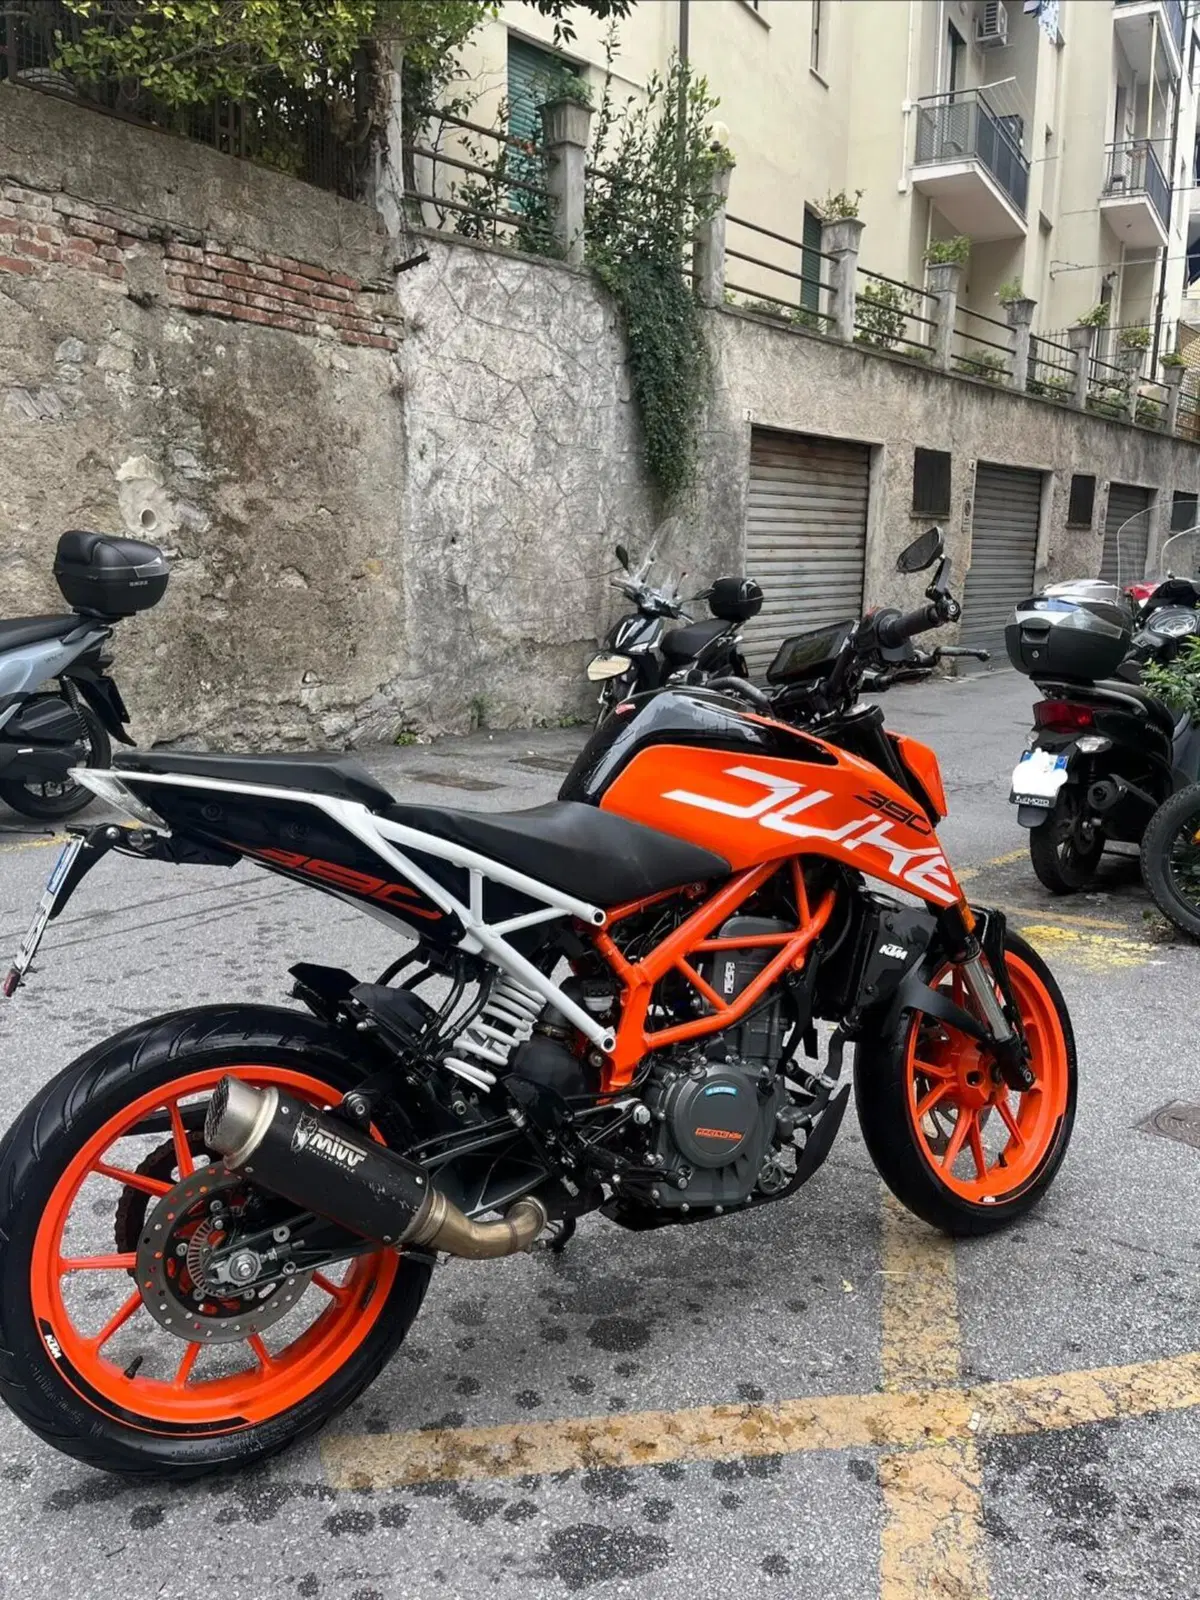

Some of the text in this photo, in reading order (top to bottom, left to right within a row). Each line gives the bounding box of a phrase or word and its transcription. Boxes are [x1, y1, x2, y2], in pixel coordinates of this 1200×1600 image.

[852, 788, 932, 836] 390
[660, 765, 959, 904] DUKE
[878, 943, 909, 960] KTM
[304, 1145, 356, 1174] ITALIAN STYLE
[44, 1334, 62, 1359] KTM
